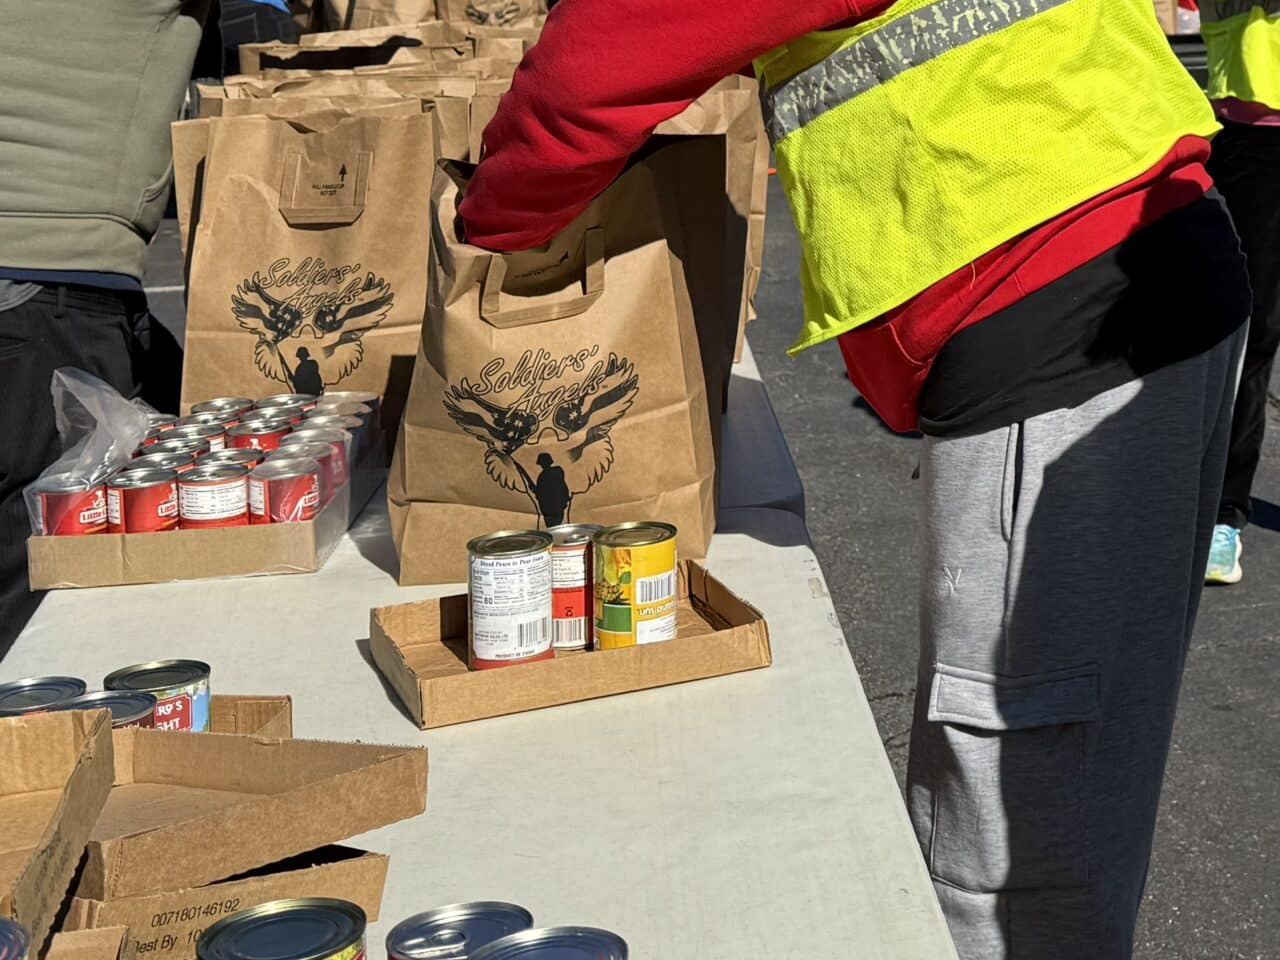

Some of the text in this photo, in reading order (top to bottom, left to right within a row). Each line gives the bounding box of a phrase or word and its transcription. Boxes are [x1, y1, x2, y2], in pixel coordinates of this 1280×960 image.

[260, 257, 361, 289] Soldiers'
[279, 277, 362, 318] Angels
[472, 344, 599, 395] Soldiers'
[505, 360, 606, 421] Angels
[151, 898, 240, 928] 007180146192
[161, 934, 178, 951] By
